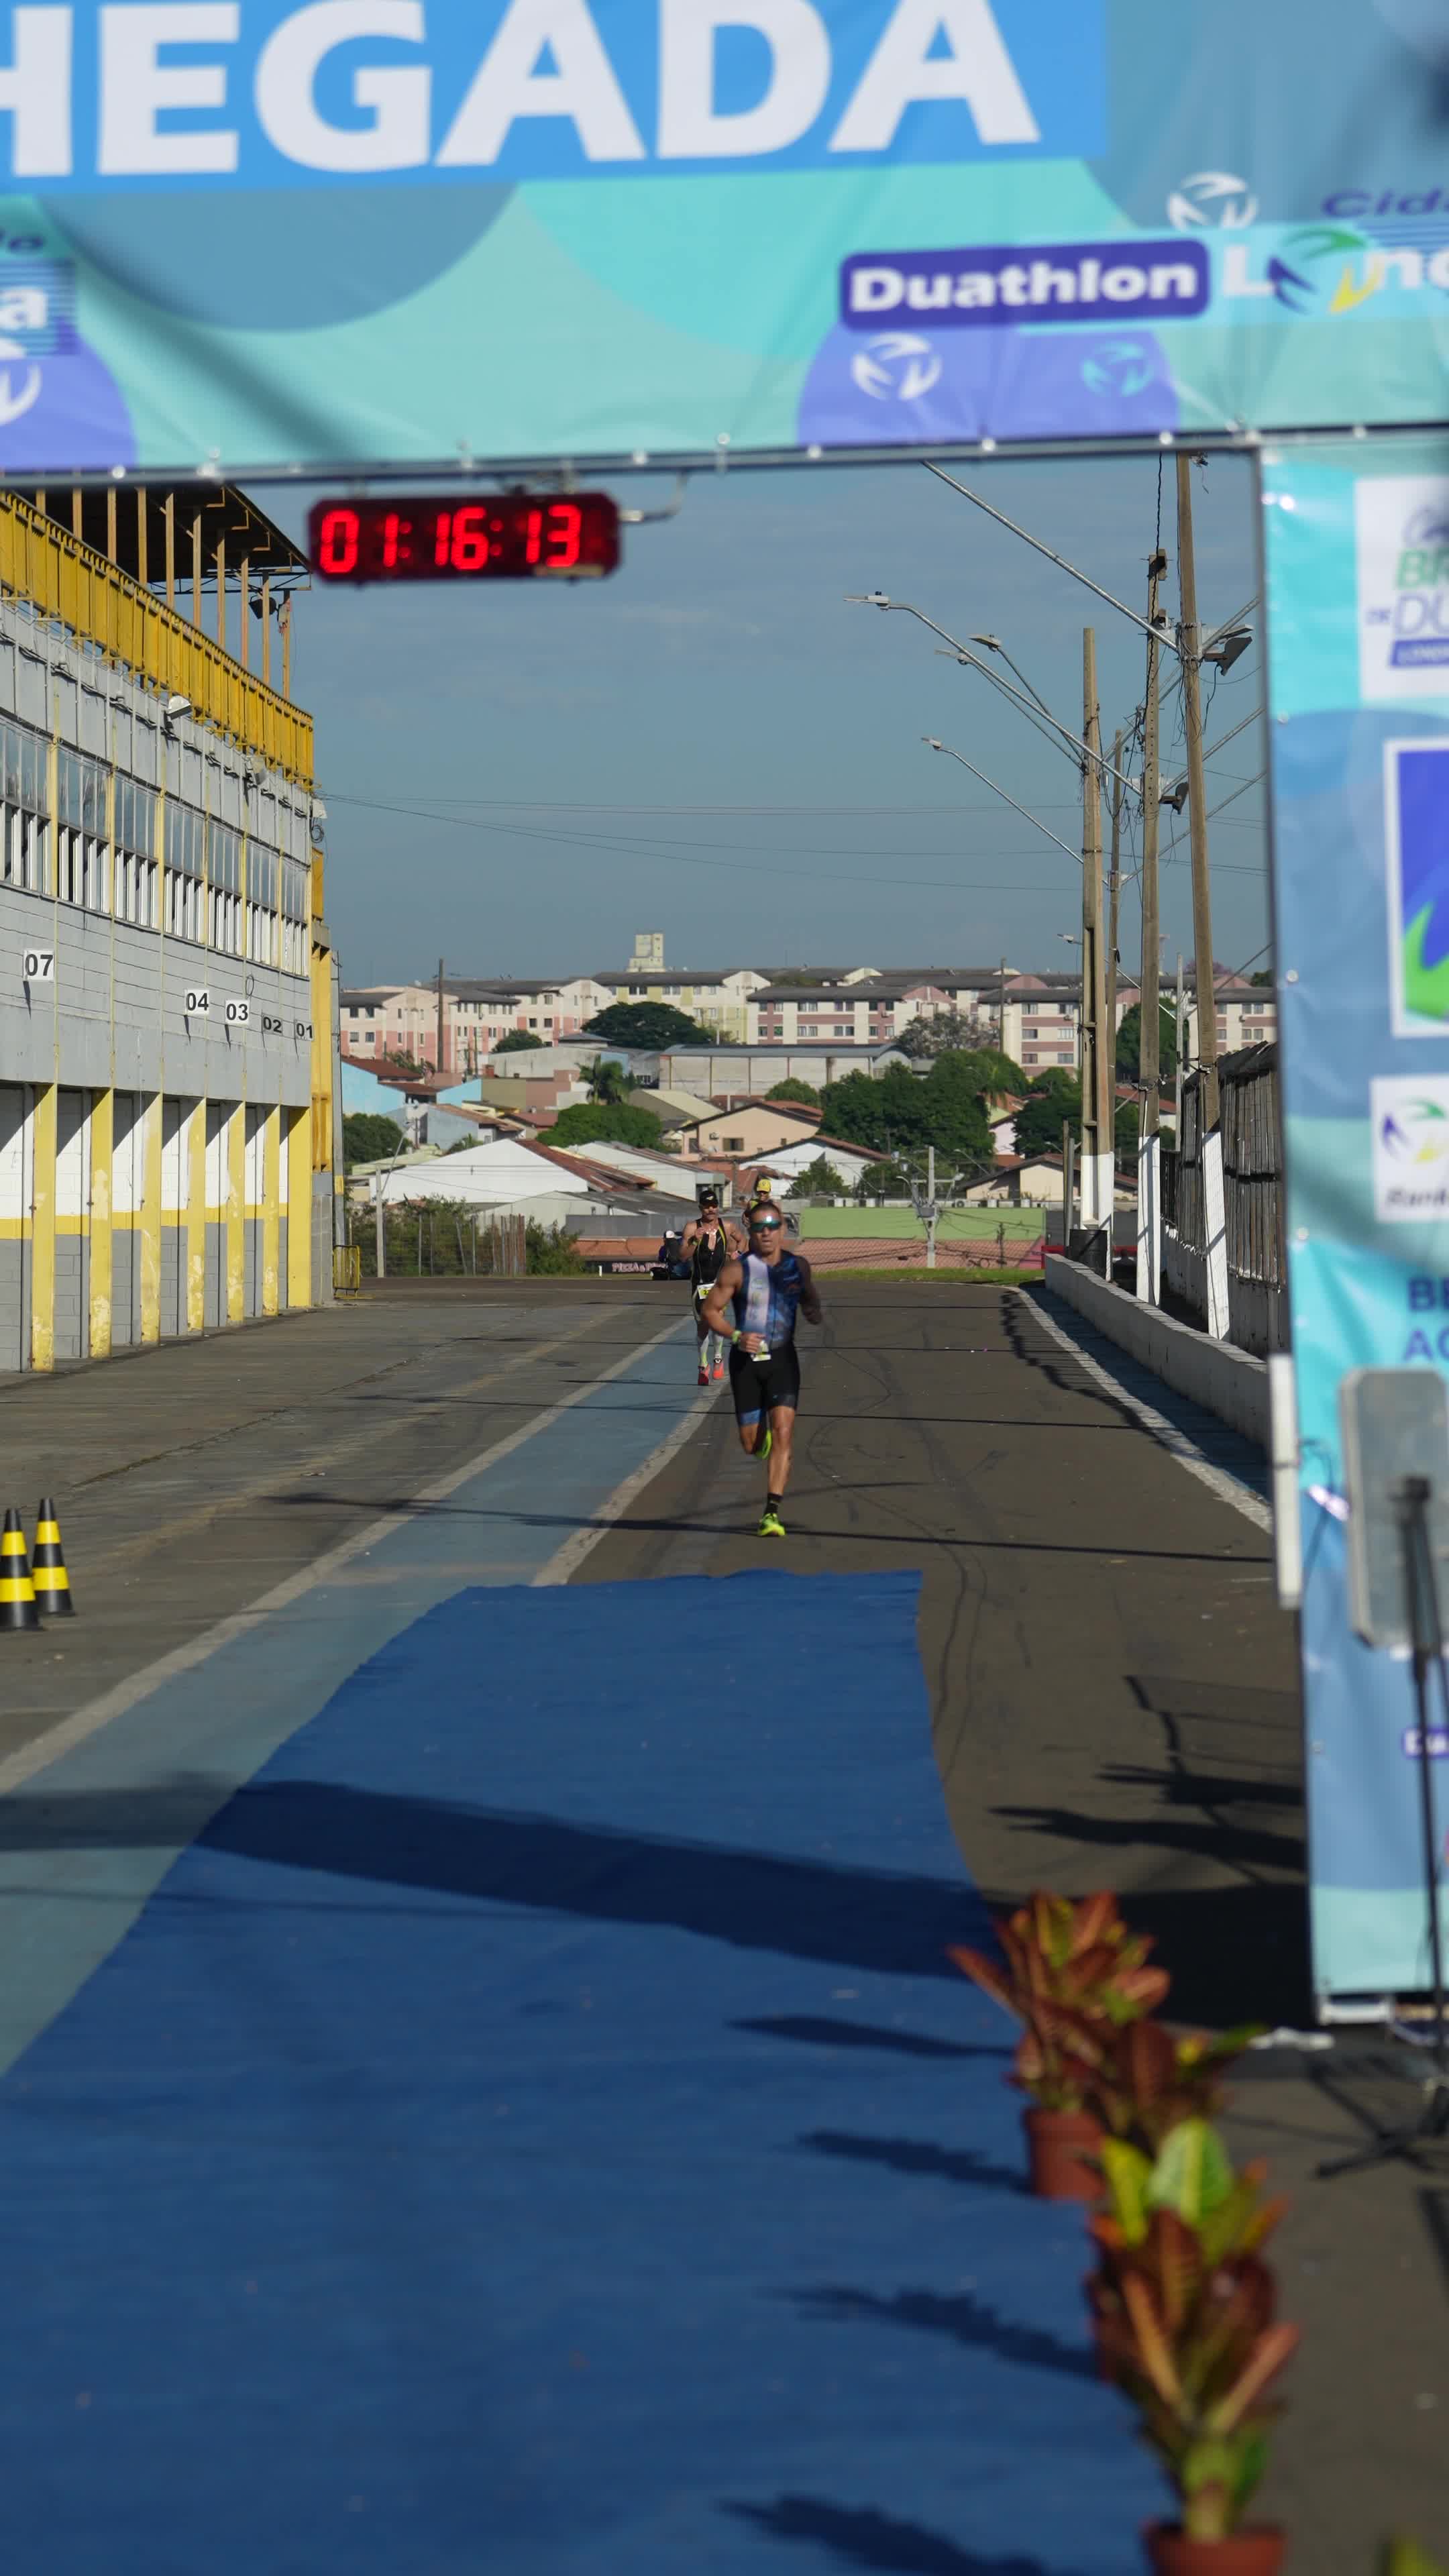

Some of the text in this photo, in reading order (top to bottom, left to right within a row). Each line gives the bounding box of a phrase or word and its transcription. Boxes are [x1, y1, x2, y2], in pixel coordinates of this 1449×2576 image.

[1322, 185, 1449, 219] Cid
[849, 258, 1198, 312] Duathlon
[319, 504, 582, 574] 01:16:13
[25, 953, 54, 977] 07
[186, 992, 209, 1011] 04
[225, 1003, 248, 1021] 03
[262, 1016, 282, 1033] 02
[295, 1022, 314, 1039] 01
